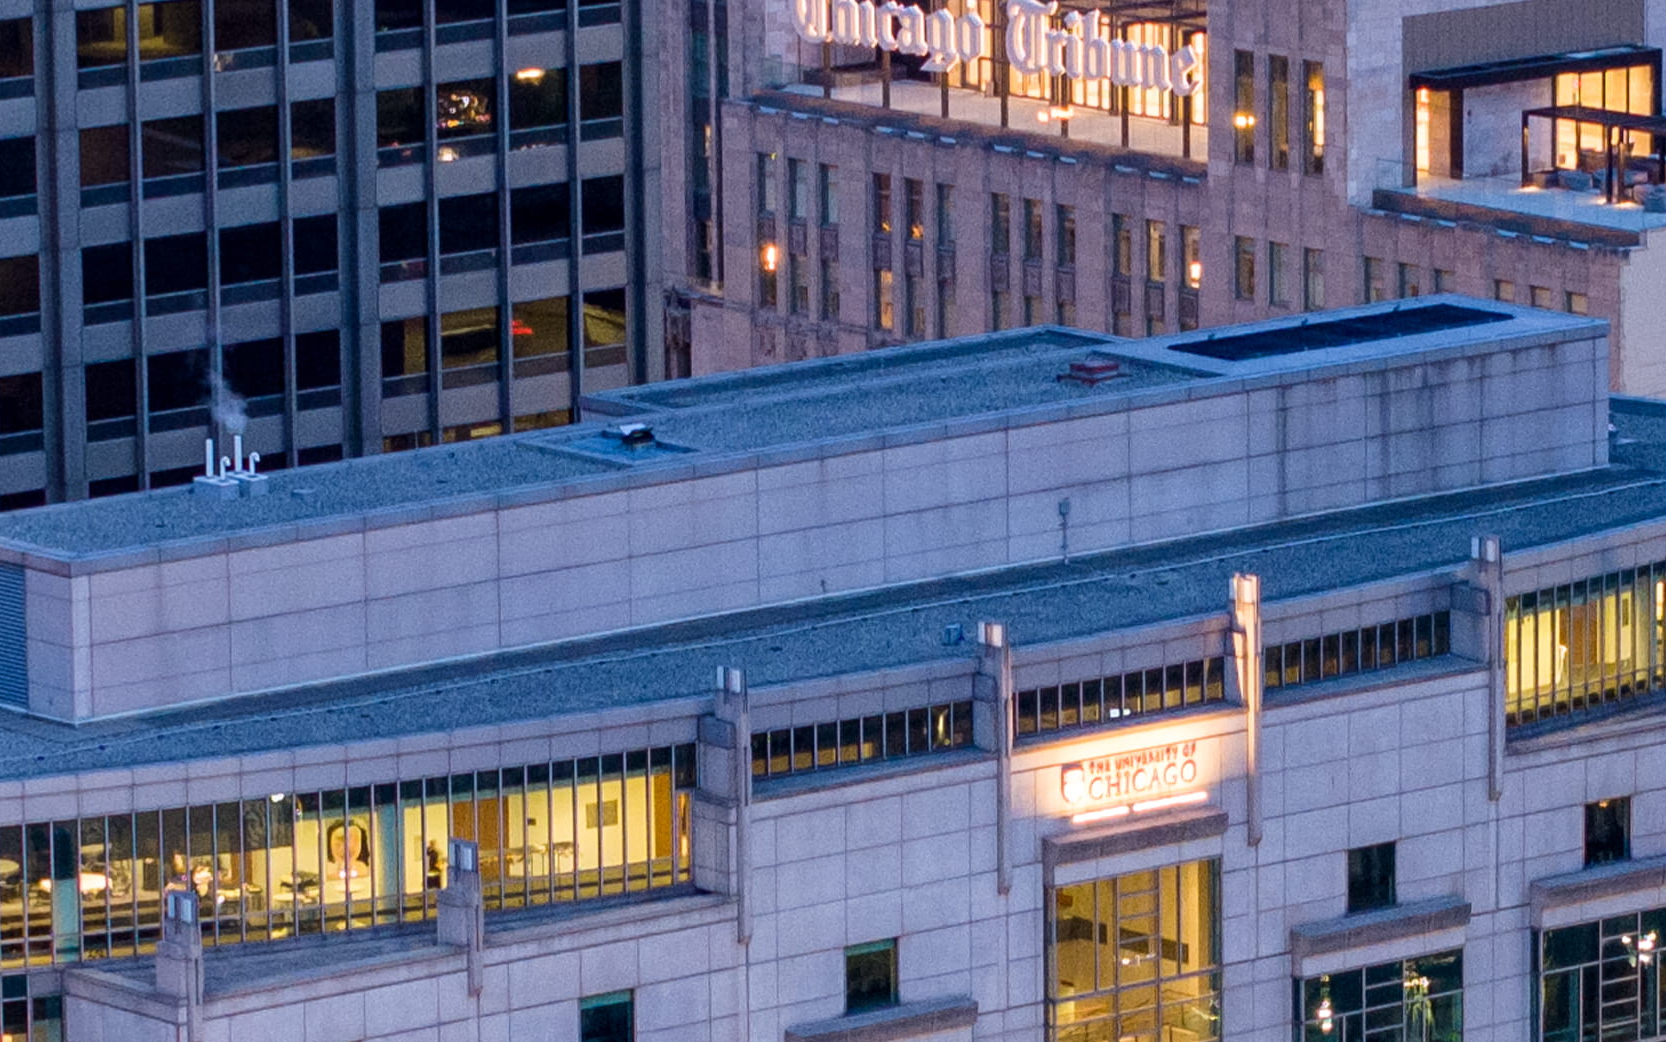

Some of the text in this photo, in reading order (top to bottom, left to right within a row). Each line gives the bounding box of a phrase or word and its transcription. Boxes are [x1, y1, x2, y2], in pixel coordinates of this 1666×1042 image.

[1005, 0, 1202, 97] Tribune
[1088, 760, 1111, 775] THE
[1114, 745, 1179, 771] UNIVERSITY
[1088, 759, 1197, 800] CHICAGO
